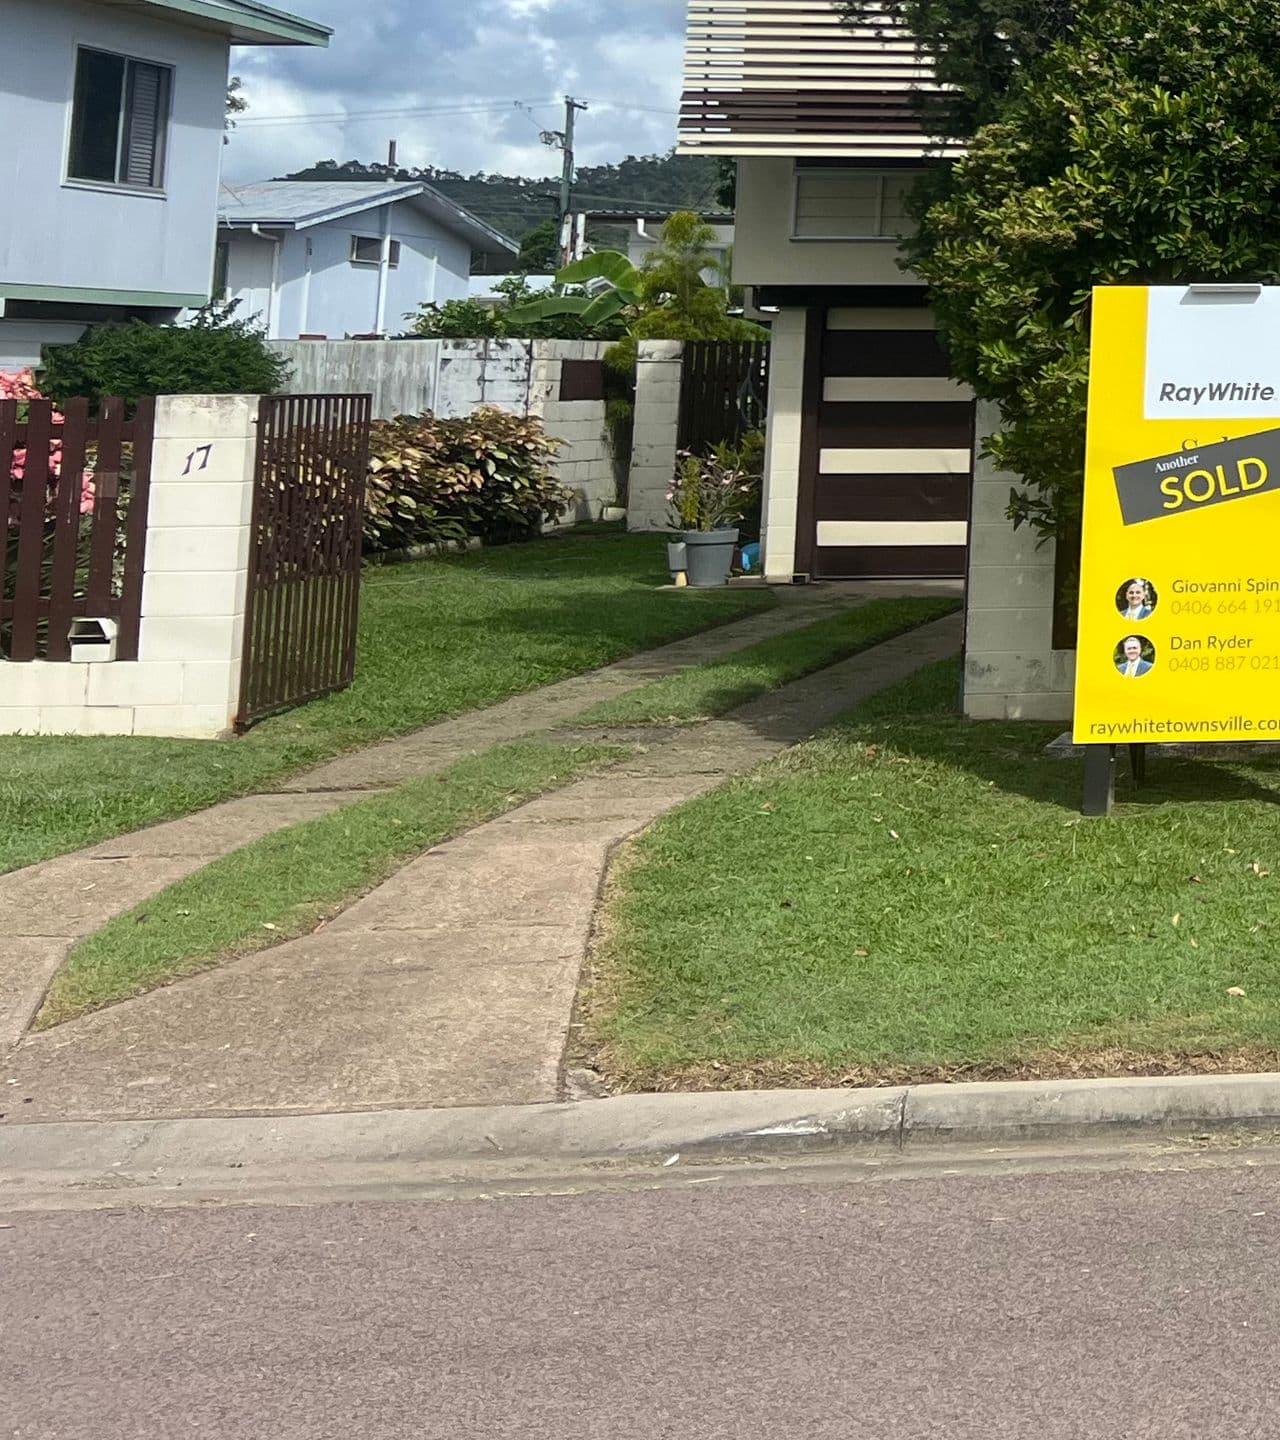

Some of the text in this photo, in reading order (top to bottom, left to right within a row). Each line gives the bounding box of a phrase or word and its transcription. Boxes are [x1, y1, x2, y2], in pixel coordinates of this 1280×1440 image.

[181, 443, 213, 476] 17
[1155, 454, 1199, 473] Another
[1160, 457, 1268, 509] SOLD
[1172, 578, 1241, 594] Giovanni
[1170, 598, 1280, 615] 0406 664 191
[1170, 635, 1254, 652] Dan Ryder
[1168, 655, 1280, 672] 0408 887 021
